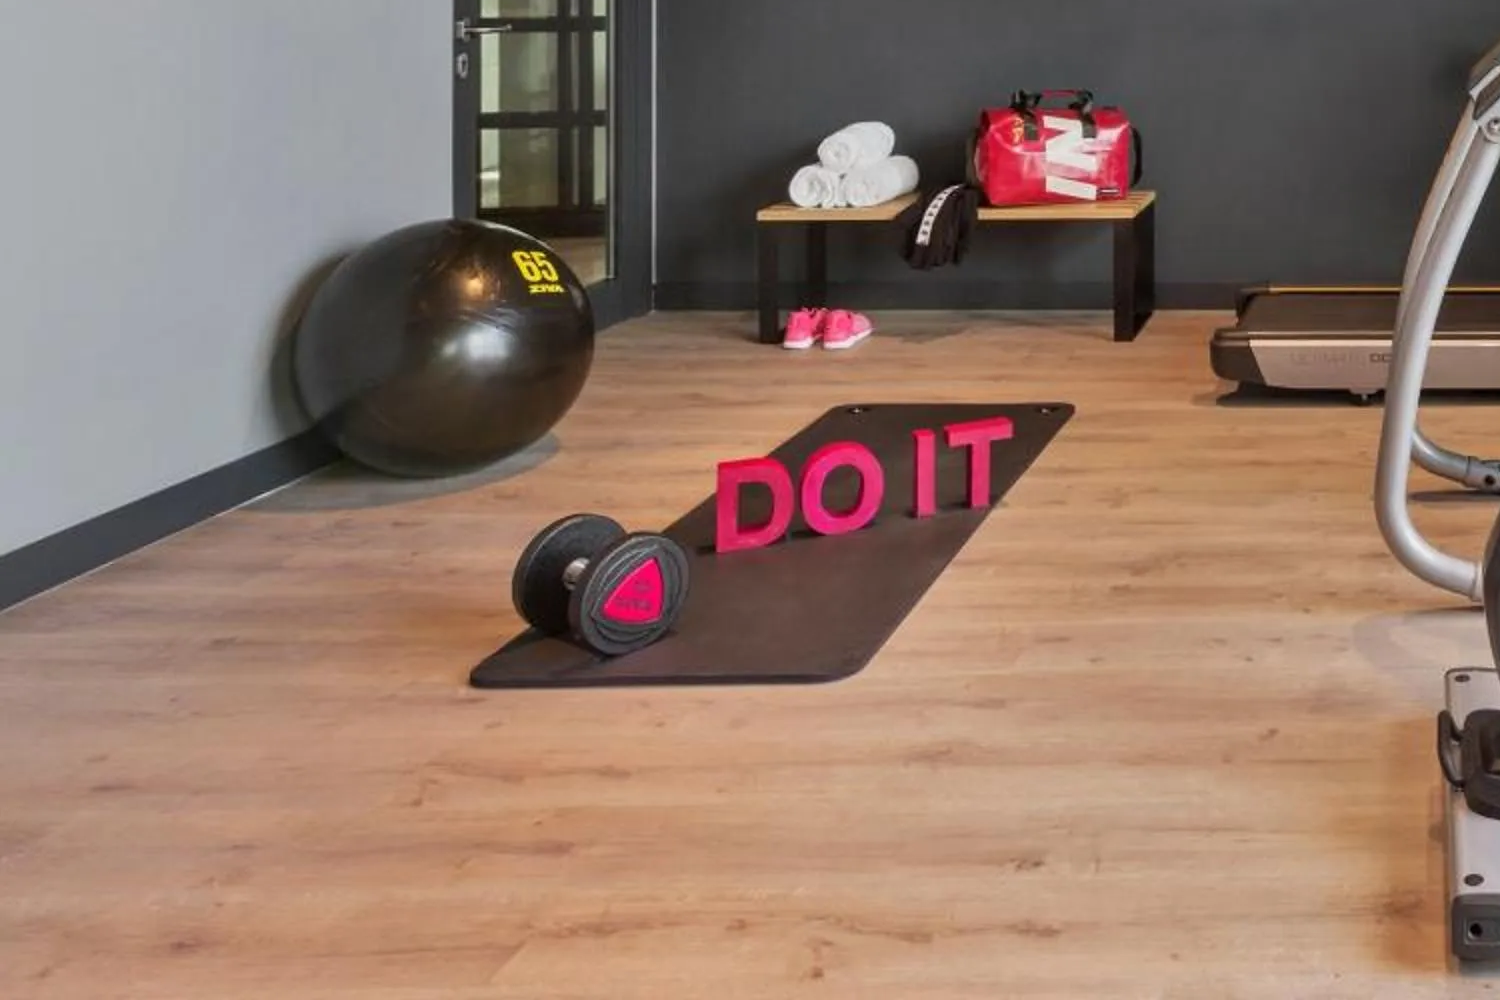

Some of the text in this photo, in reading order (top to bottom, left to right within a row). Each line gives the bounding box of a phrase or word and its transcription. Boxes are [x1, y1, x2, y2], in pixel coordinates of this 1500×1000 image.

[512, 251, 559, 282] 65
[715, 416, 1014, 554] DO IT
